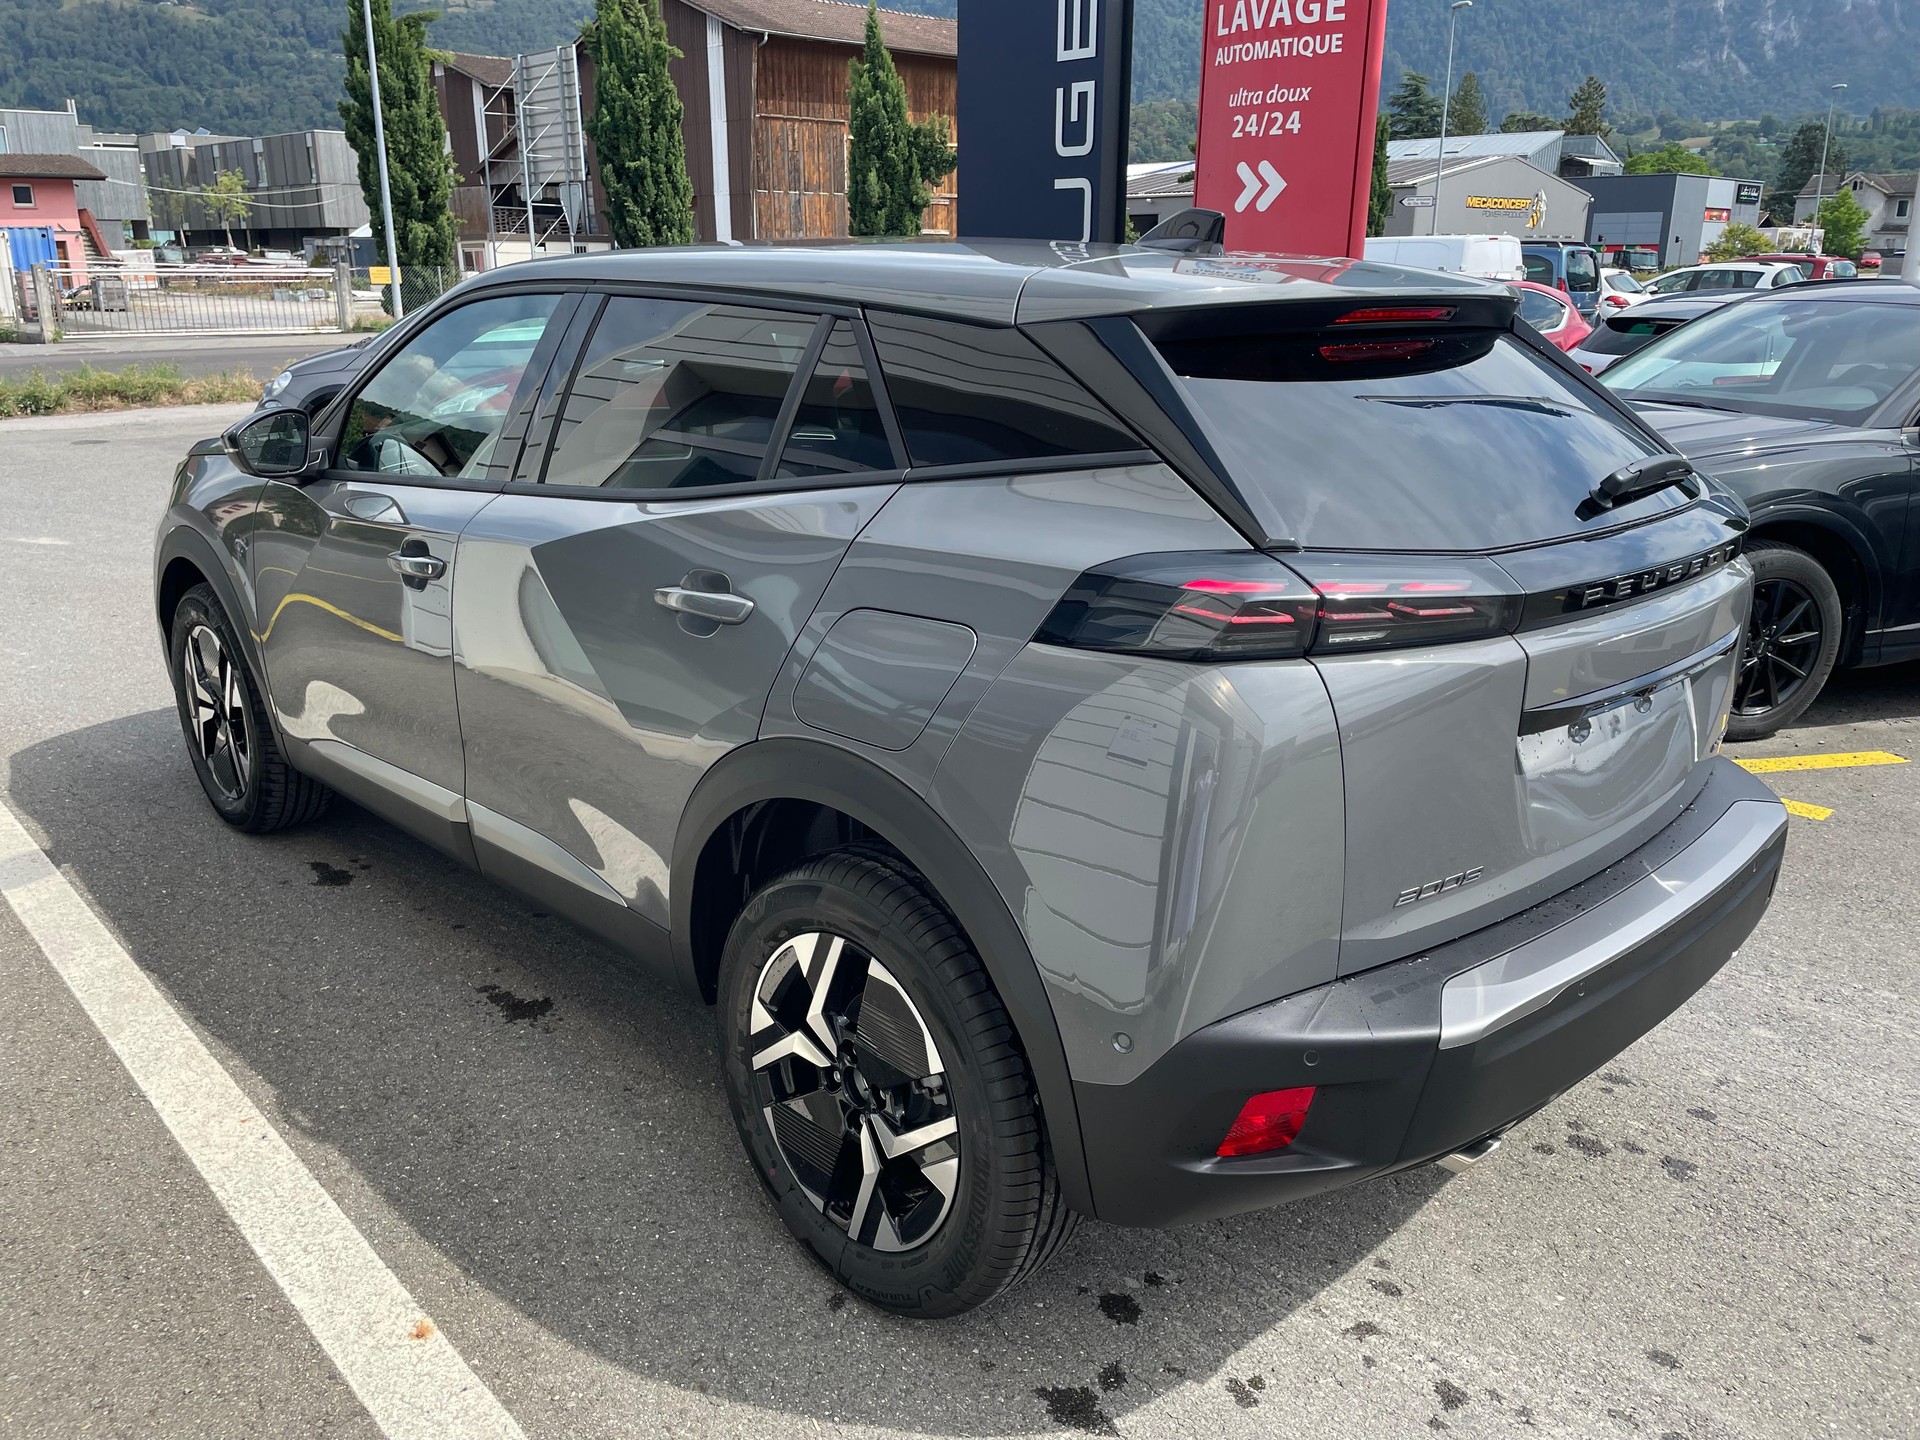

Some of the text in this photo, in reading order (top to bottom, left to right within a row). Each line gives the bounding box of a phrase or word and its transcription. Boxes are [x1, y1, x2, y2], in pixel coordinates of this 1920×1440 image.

[1217, 0, 1346, 36] LAVAGE
[1215, 33, 1343, 66] AUTOMATIQUE
[1229, 84, 1312, 108] ultra doux
[1231, 111, 1302, 138] 24/24
[1466, 196, 1532, 210] MECACONCEPT
[1482, 210, 1529, 219] POWER PRODUCTS
[1582, 545, 1735, 609] PEUGEOT
[1392, 865, 1484, 909] 2008
